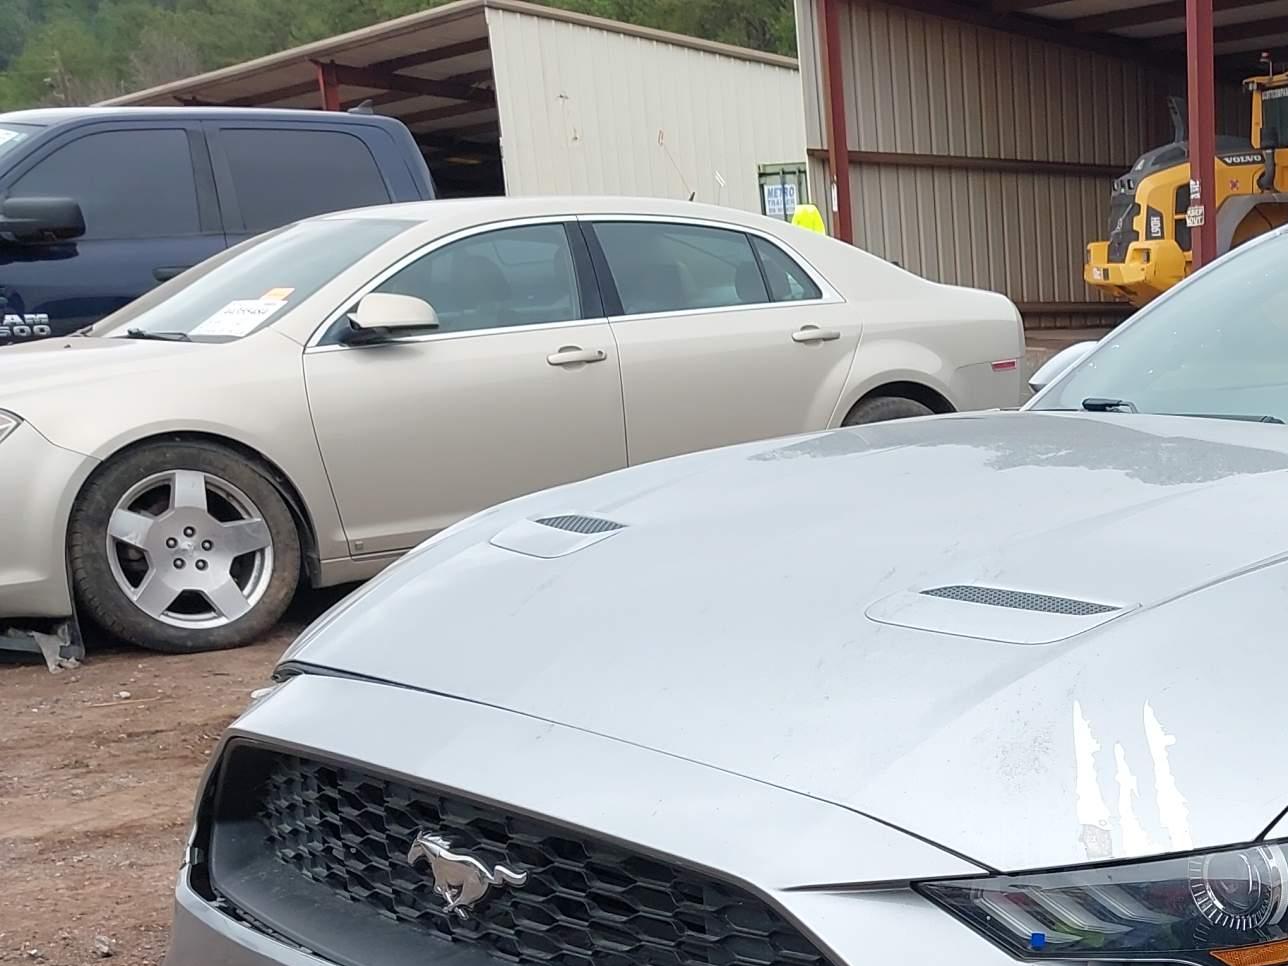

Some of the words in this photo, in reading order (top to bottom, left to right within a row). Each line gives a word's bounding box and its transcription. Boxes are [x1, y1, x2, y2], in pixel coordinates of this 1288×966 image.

[1223, 155, 1262, 164] VOLVO
[768, 199, 795, 207] TRAIER
[0, 313, 50, 326] AM
